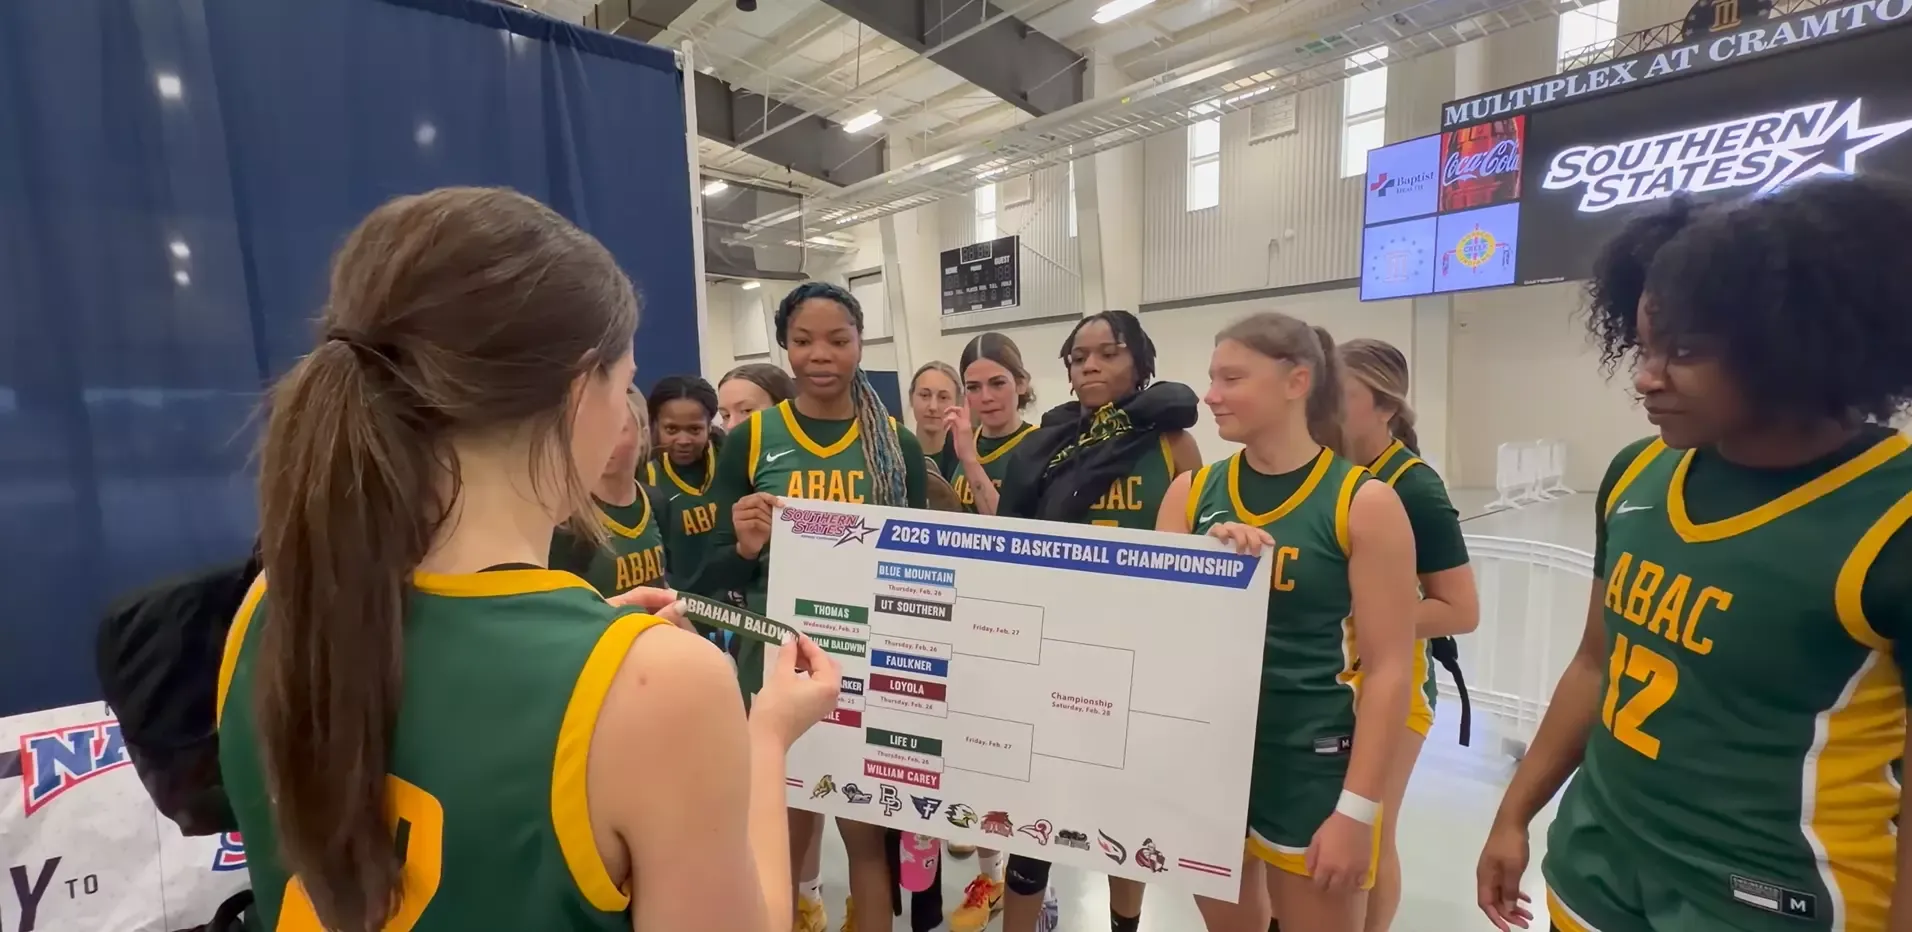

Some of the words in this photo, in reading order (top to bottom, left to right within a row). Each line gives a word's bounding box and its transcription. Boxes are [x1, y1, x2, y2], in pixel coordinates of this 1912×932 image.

[1443, 59, 1639, 127] MULTIPLEX
[1644, 45, 1699, 79] AT
[1709, 0, 1912, 62] CRAMTO
[1549, 105, 1831, 185] SOUTHERN
[1397, 171, 1434, 187] Baptist
[1585, 149, 1783, 208] STATES
[787, 470, 865, 504] ABAC
[1090, 476, 1143, 510] AC
[781, 506, 860, 527] SOUTHERN
[792, 520, 845, 537] STATES
[891, 525, 931, 545] 2026
[936, 529, 1006, 553] WOMEN'S
[1011, 537, 1109, 564] BASKETBALL
[1116, 548, 1244, 578] CHAMPIONSHIP
[879, 565, 901, 578] BLUE
[904, 567, 953, 583] MOUNTAIN
[919, 587, 932, 596] Feb.
[813, 604, 850, 619] THOMAS
[881, 600, 894, 611] UT
[897, 601, 946, 618] SOUTHERN
[1604, 551, 1734, 656] ABAC
[972, 623, 995, 634] Friday,
[996, 627, 1010, 636] Feb.
[831, 638, 866, 653] BALDWIN
[915, 643, 928, 652] Feb.
[886, 655, 932, 672] FAULKNER
[841, 679, 862, 692] RKER
[889, 679, 925, 695] LOYOLA
[1051, 691, 1113, 709] Championship
[1602, 632, 1679, 761] 12
[822, 711, 841, 722] ILE
[1051, 701, 1084, 713] Saturday,
[1085, 706, 1101, 715] Feb.
[889, 734, 907, 748] LIFE
[910, 738, 918, 749] U
[965, 736, 988, 747] Friday,
[988, 740, 1002, 749] Feb.
[29, 723, 127, 802] NA
[907, 755, 921, 764] Feb.
[866, 763, 904, 779] WILLIAM
[907, 771, 937, 786] CAREY
[65, 874, 99, 899] TO
[1790, 897, 1807, 913] M
